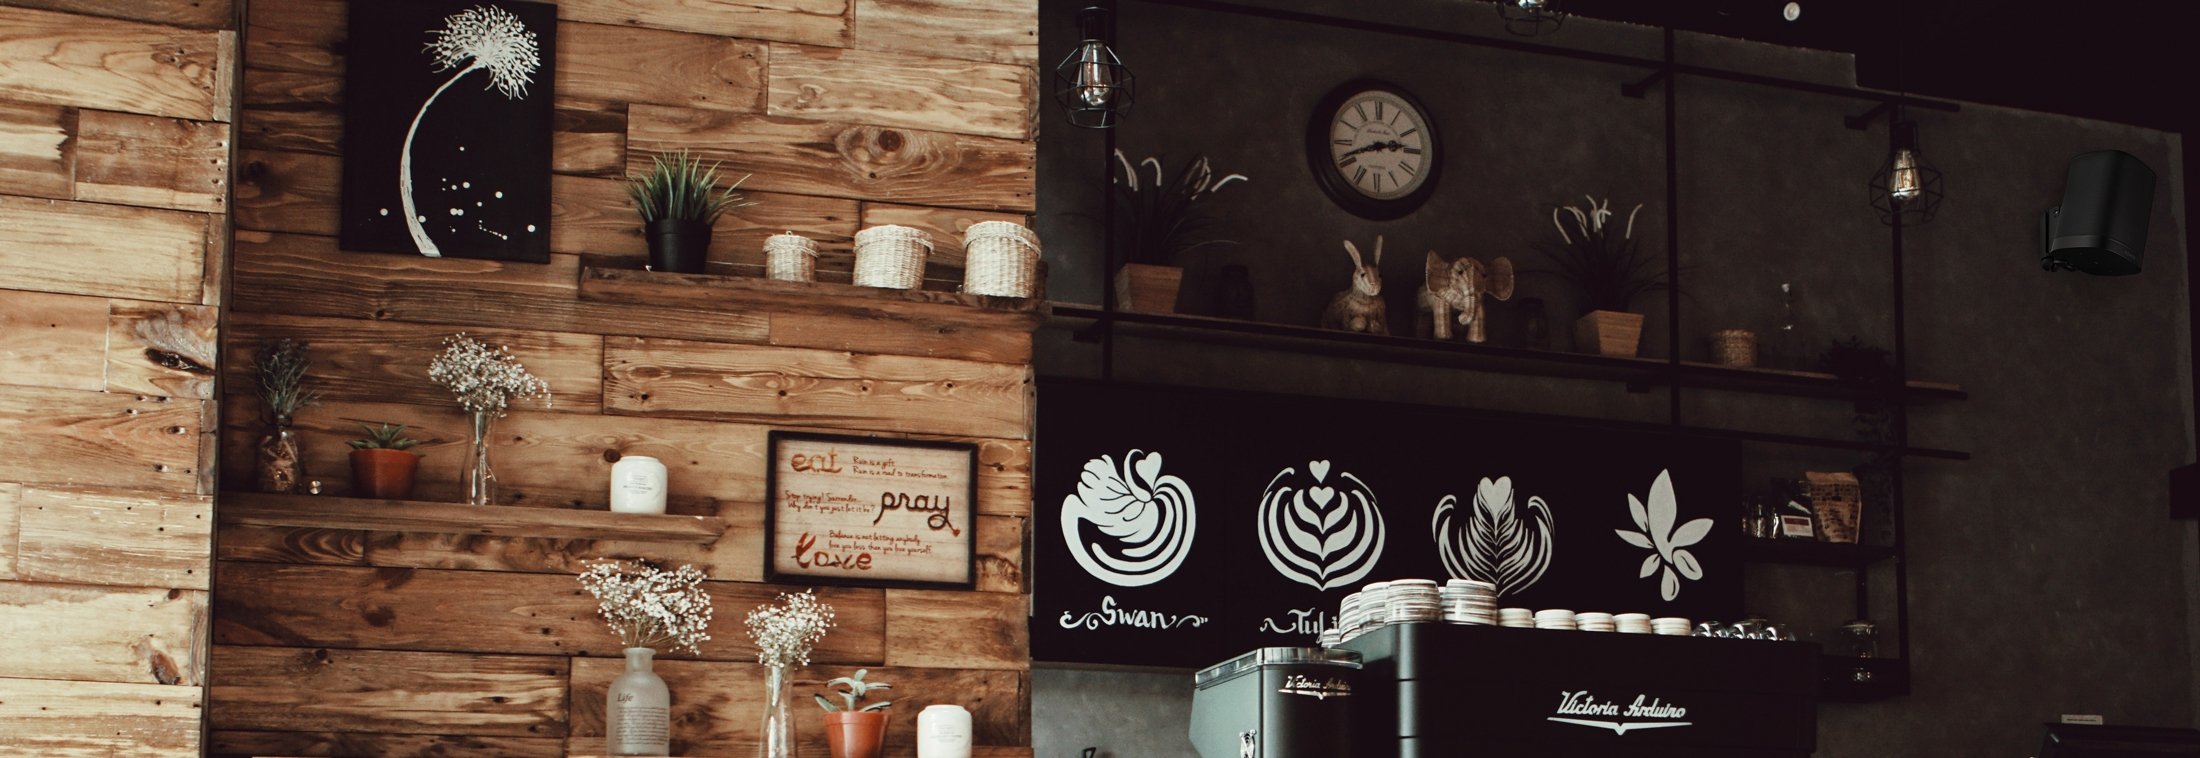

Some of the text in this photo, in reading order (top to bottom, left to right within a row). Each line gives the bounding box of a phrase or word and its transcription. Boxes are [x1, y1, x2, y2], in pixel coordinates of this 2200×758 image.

[791, 447, 843, 473] eat
[788, 500, 801, 512] Why
[873, 492, 953, 532] pray
[791, 532, 872, 570] love
[1100, 595, 1177, 630] Swan
[1286, 607, 1338, 645] Tuli
[617, 692, 634, 704] Life
[1557, 690, 1686, 719] Victoria Arduino
